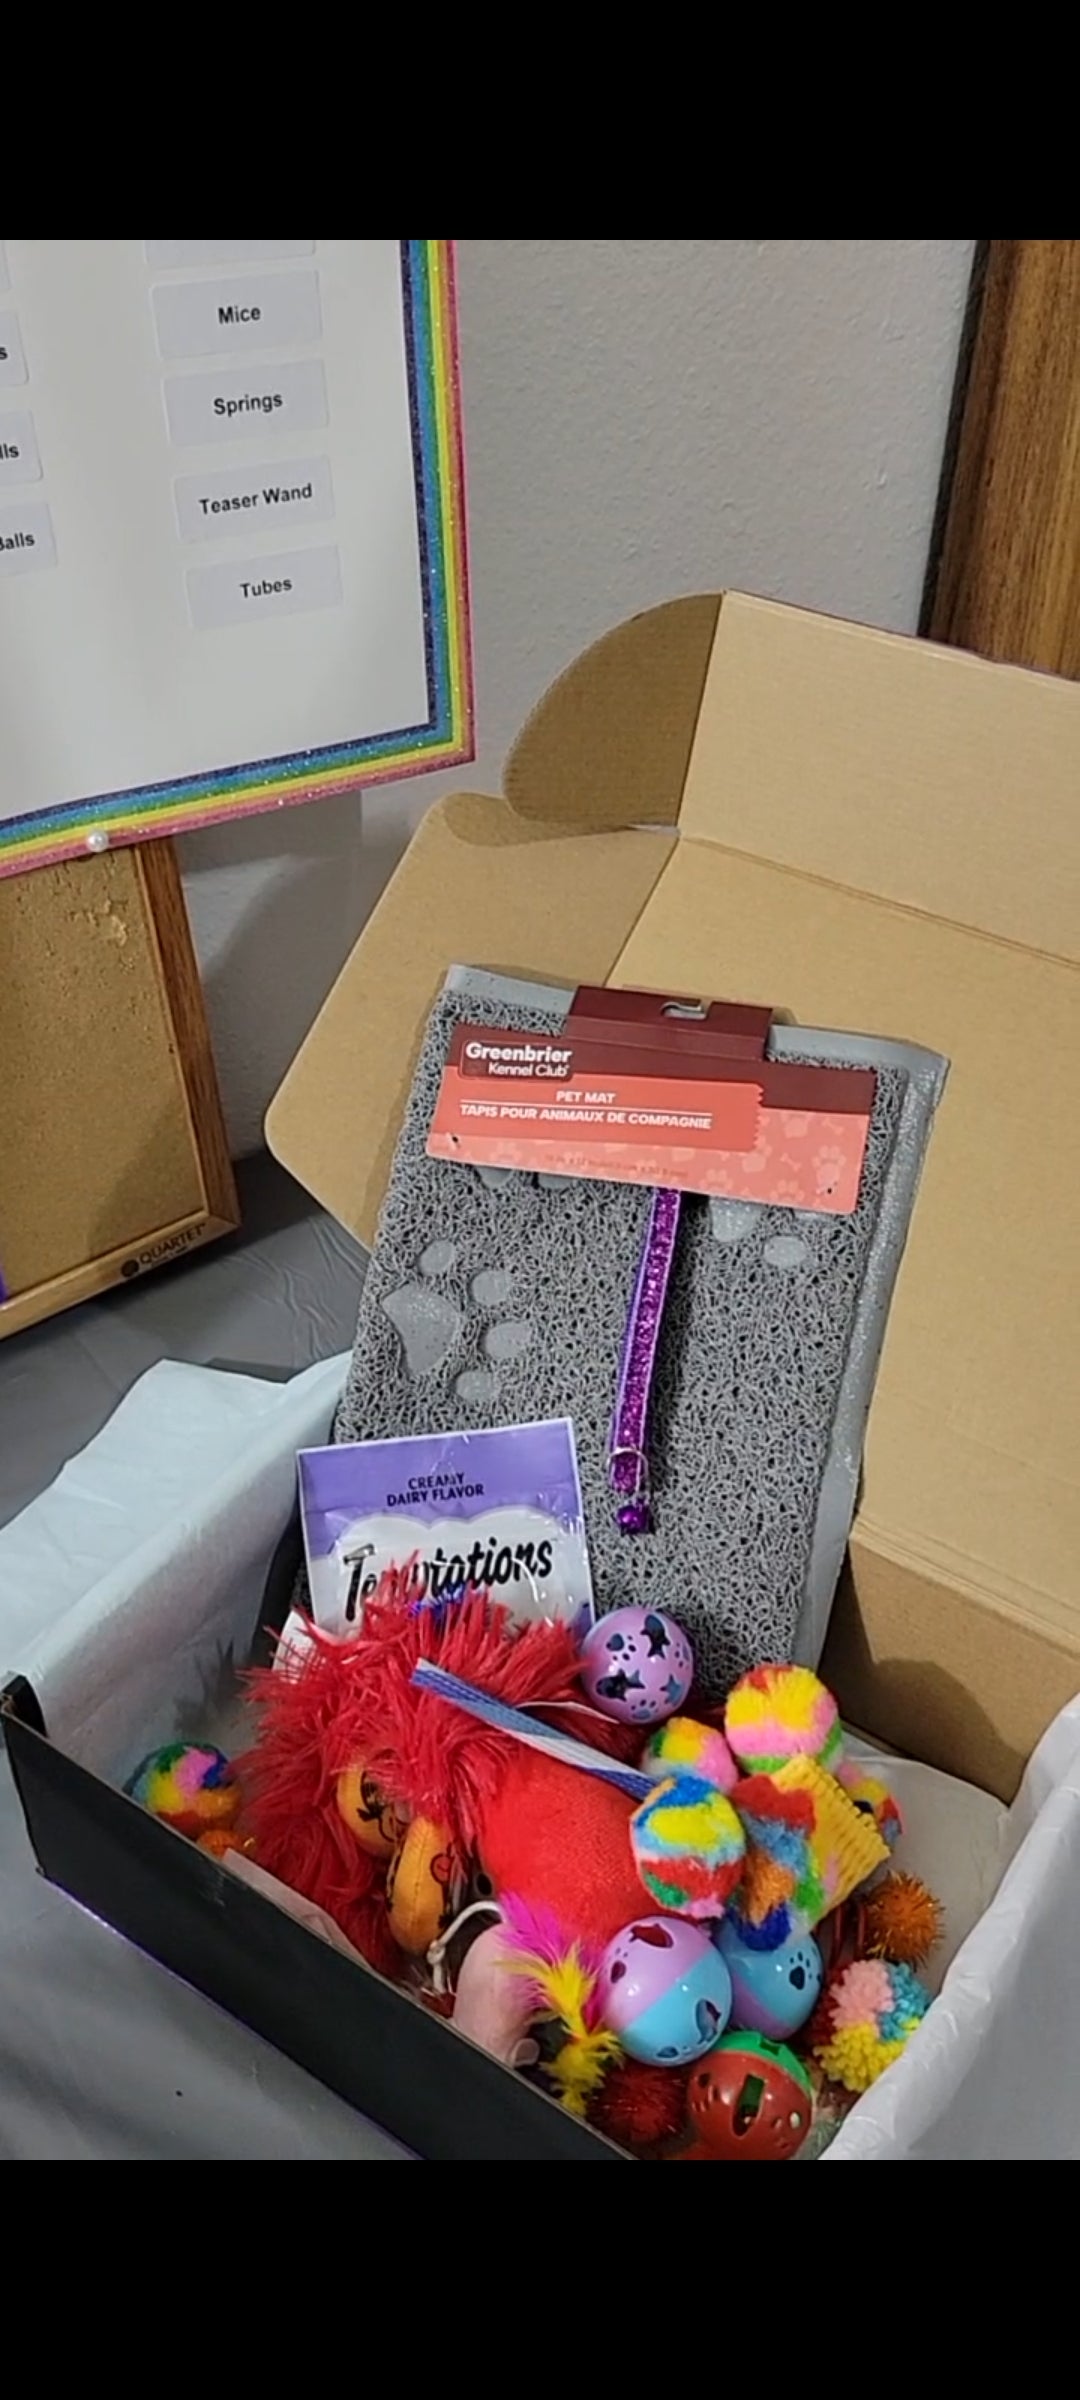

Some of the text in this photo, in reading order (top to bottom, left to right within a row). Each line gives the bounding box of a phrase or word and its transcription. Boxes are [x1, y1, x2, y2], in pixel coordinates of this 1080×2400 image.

[217, 305, 261, 325] Mice
[213, 392, 283, 416] Springs
[199, 483, 313, 515] Teaser Wand
[239, 577, 293, 599] Tubes
[465, 1042, 572, 1063] Greenbrier
[488, 1062, 533, 1077] Kennel
[556, 1090, 616, 1104] PET MAT
[460, 1104, 713, 1130] TAPIS POUR ANIMAUX DE COMPAGNIE
[408, 1472, 465, 1490] CREAMY
[387, 1483, 485, 1507] DAIRY FLAVOR
[343, 1537, 553, 1622] Tetations
